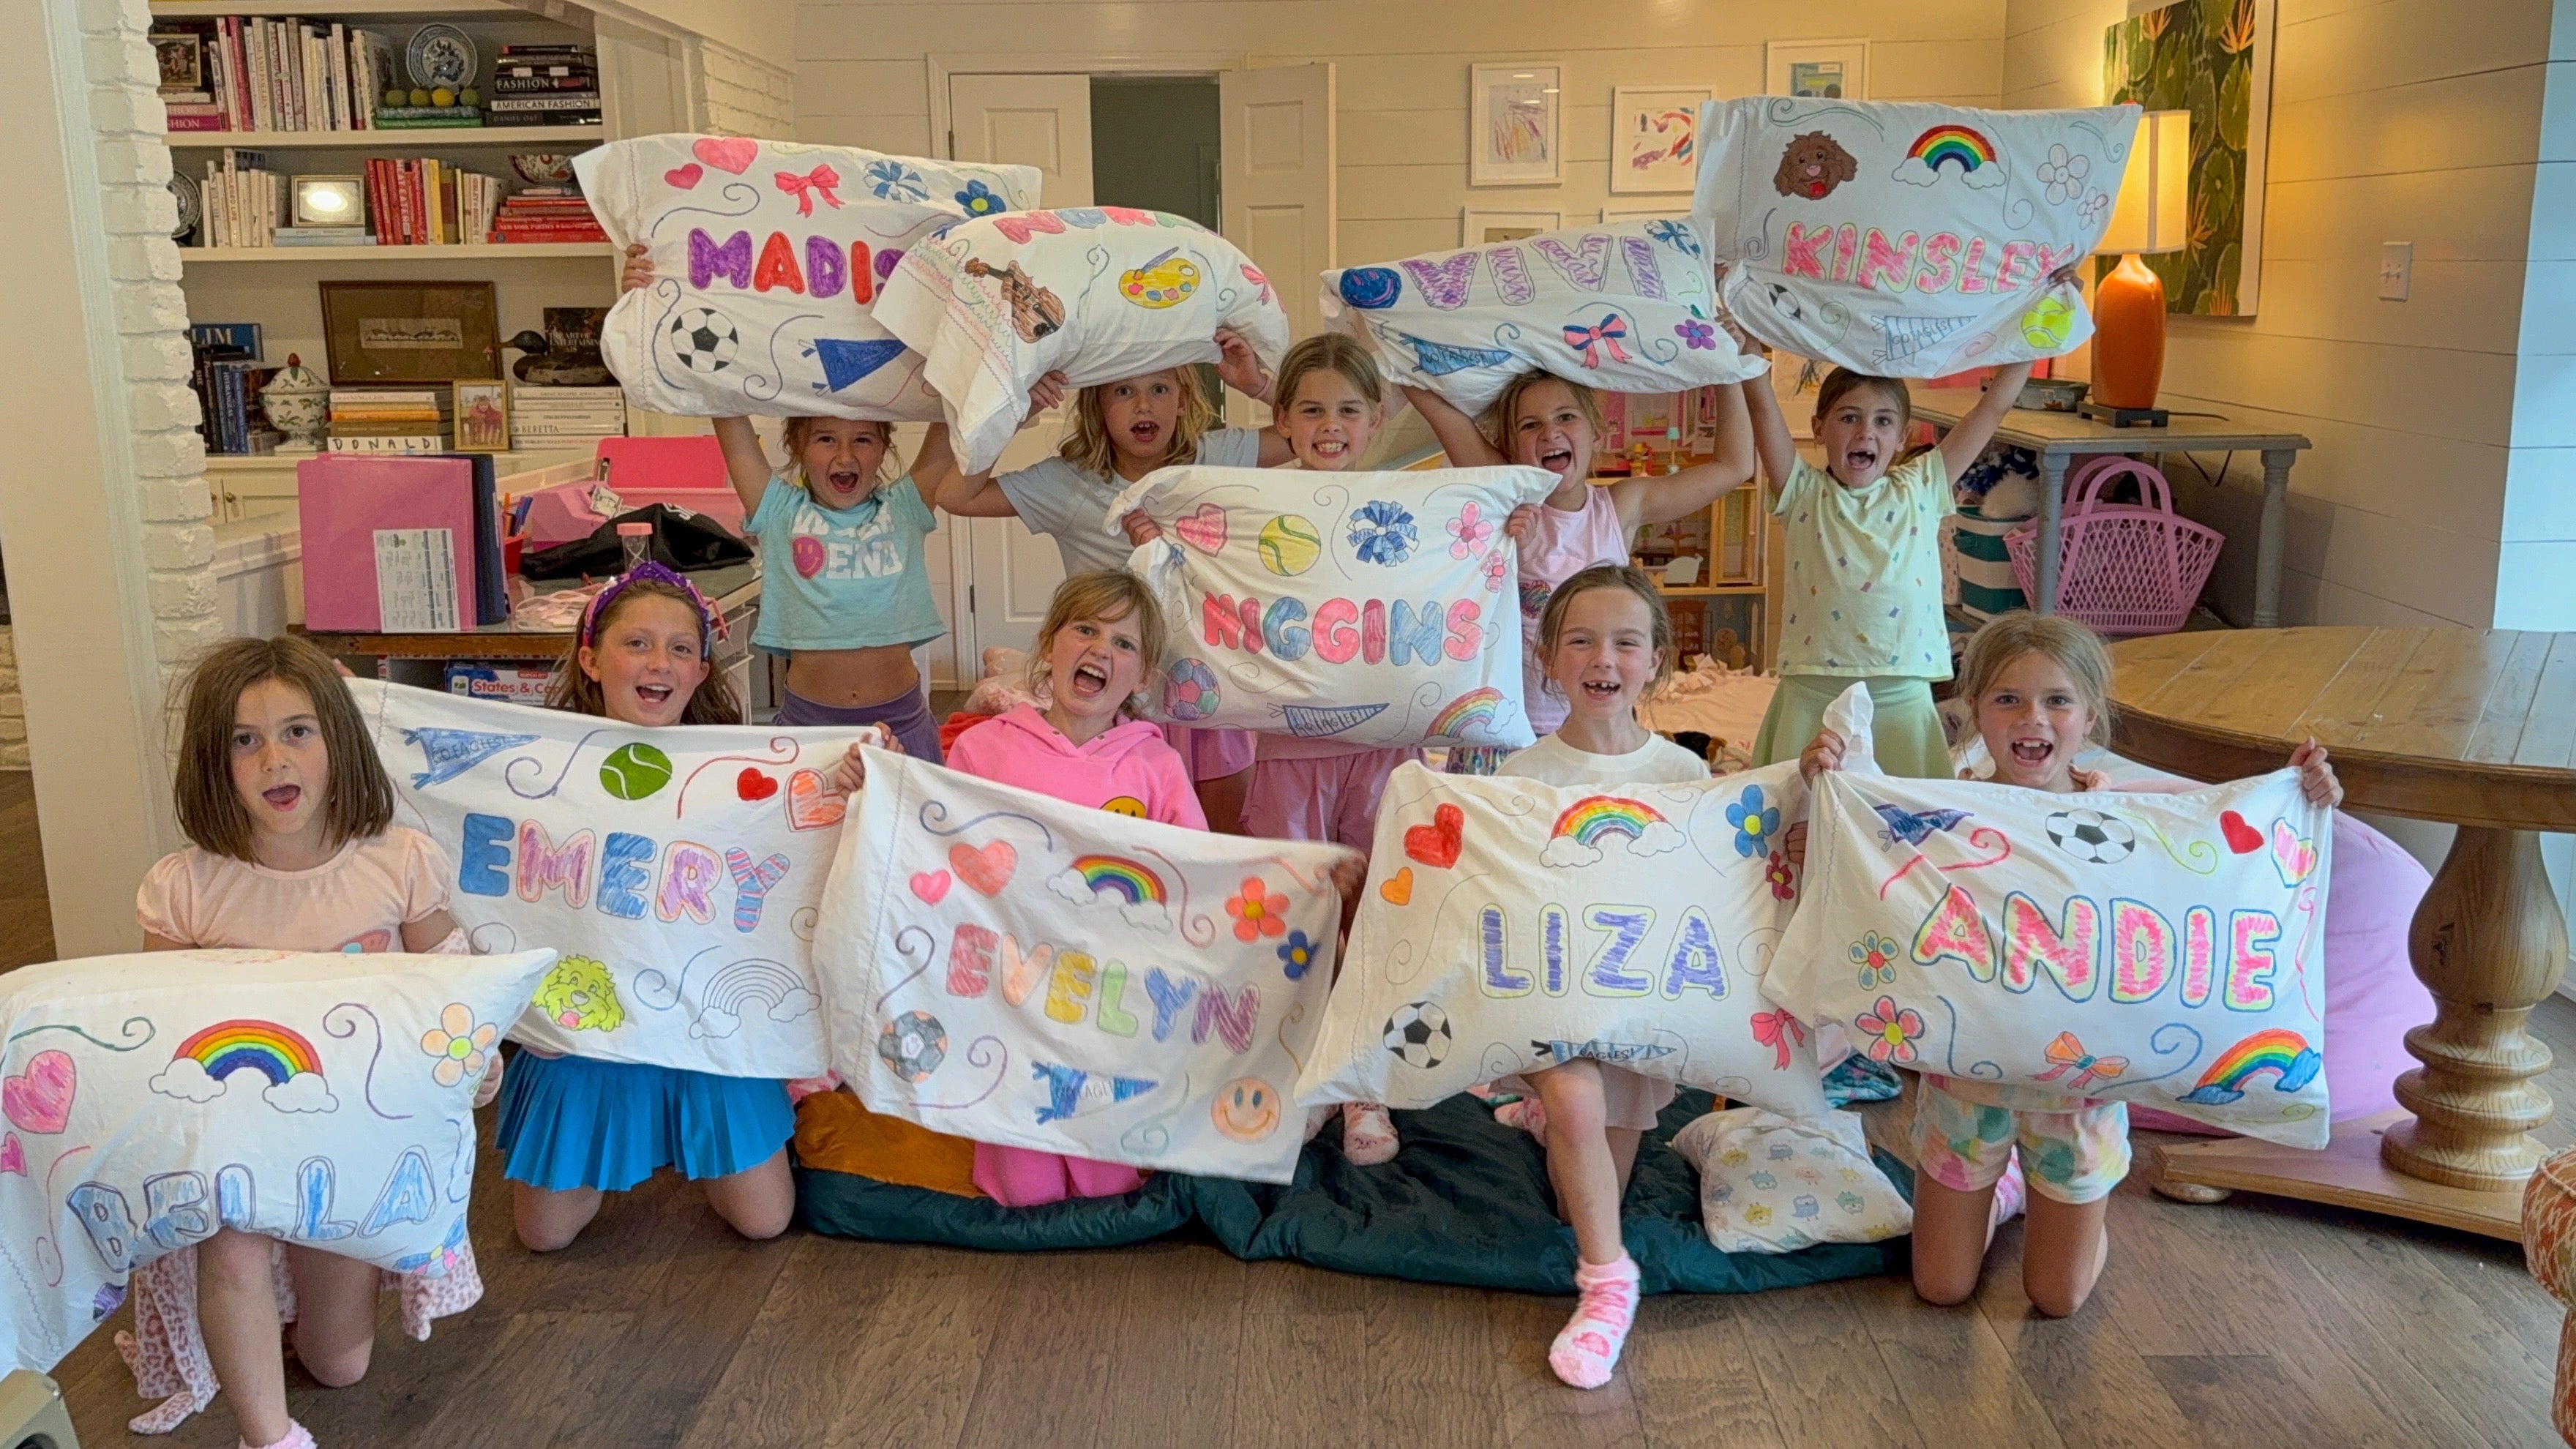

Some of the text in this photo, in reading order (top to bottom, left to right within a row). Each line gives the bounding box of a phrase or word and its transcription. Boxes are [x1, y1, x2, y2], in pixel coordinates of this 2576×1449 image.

[270, 31, 280, 70] SECOND
[497, 78, 549, 89] FASHION
[497, 100, 590, 110] AMERICAN FASHION
[227, 162, 236, 206] PRIVILEGED
[1399, 233, 1668, 311] VIVI
[1782, 222, 2074, 295] KINSLEY
[332, 437, 430, 451] DONALD
[522, 424, 560, 434] BERETTA
[473, 681, 516, 694] States
[520, 683, 530, 694] &
[459, 812, 790, 933] EMERY
[1477, 903, 1731, 1001] LIZA
[1910, 882, 2281, 1013] ANDIE
[946, 923, 1262, 1055] EVELYN
